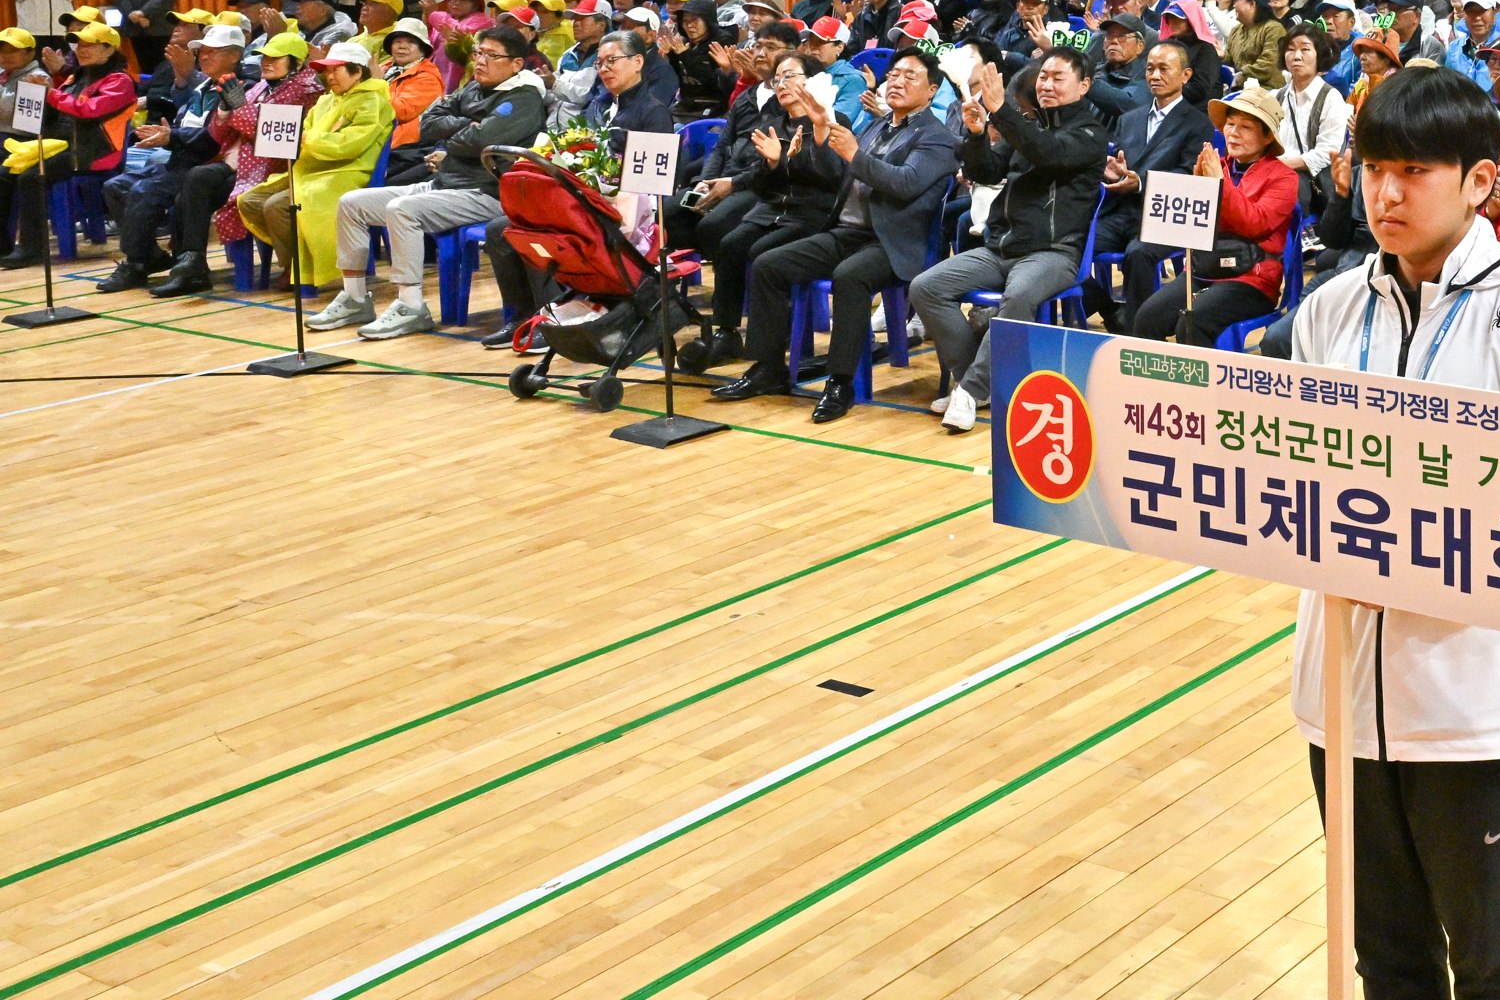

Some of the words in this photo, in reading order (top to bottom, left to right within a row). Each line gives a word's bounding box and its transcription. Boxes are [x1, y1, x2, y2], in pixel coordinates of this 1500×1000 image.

[17, 96, 42, 118] 북평면
[261, 119, 297, 143] 여량면
[1149, 194, 1210, 228] 화암면
[1216, 363, 1293, 399] 가리왕산
[1299, 373, 1359, 411] 올림픽
[1366, 383, 1449, 426] 국가정원
[1456, 397, 1500, 430] 조성
[1016, 392, 1076, 487] 경
[1123, 401, 1207, 445] 제43회
[1216, 410, 1393, 478] 정선군민의
[1420, 441, 1453, 488] 날
